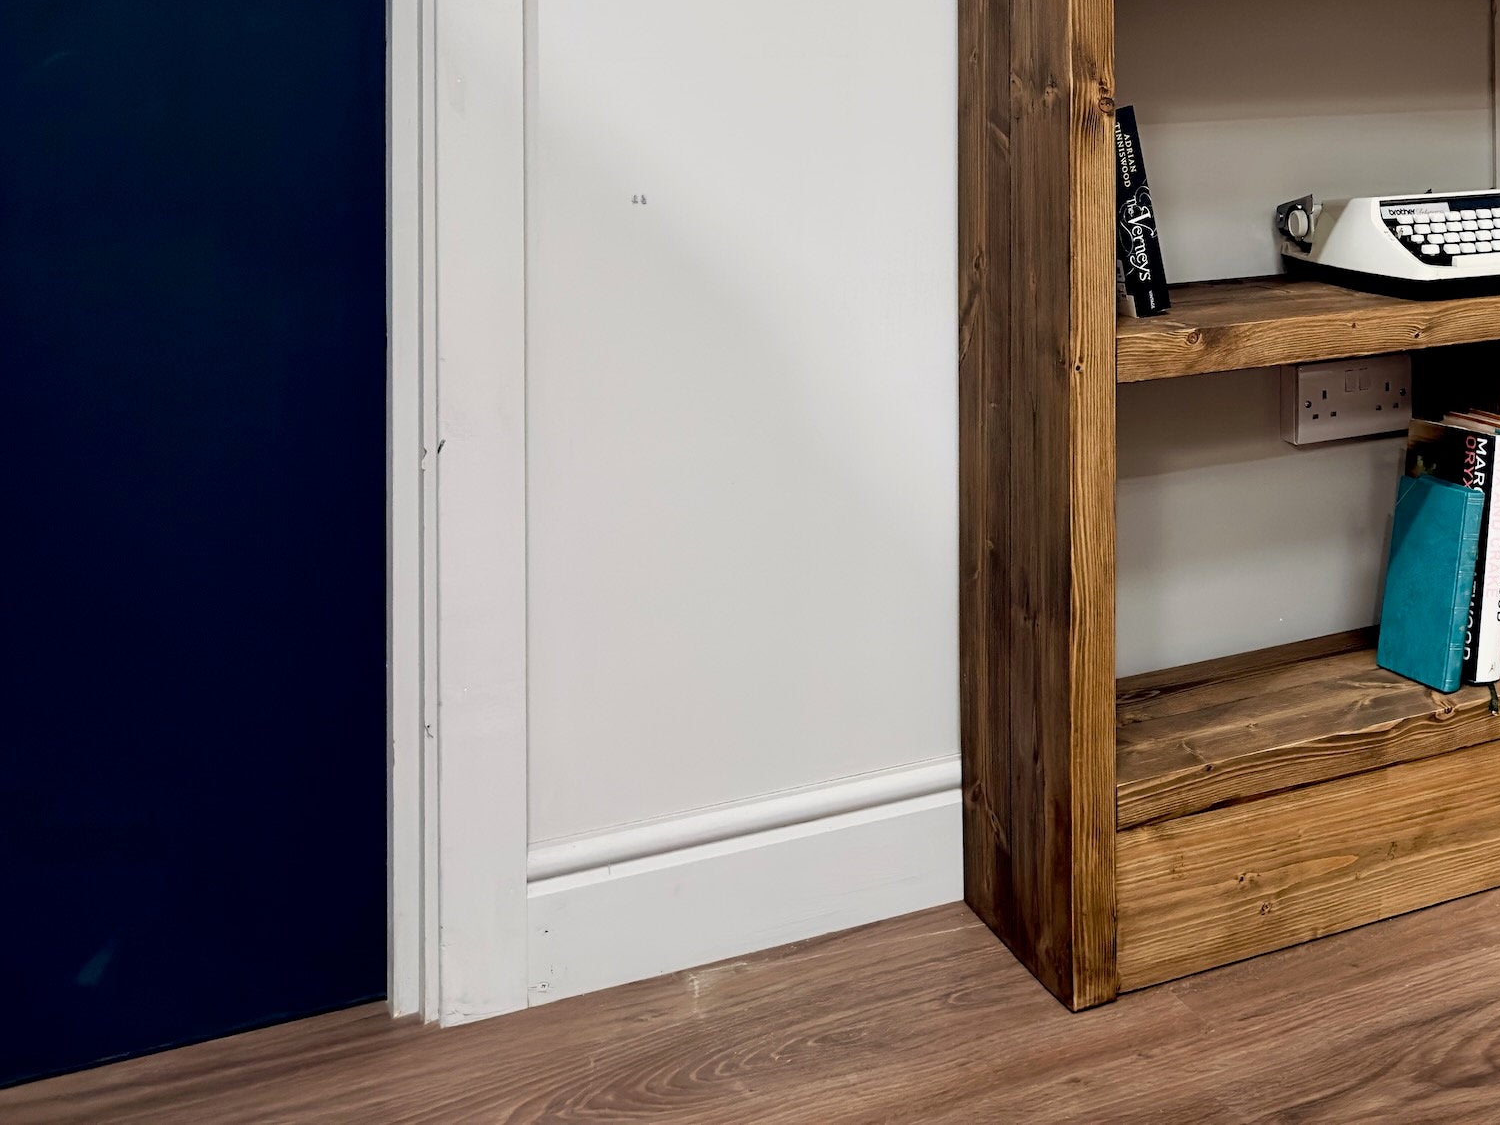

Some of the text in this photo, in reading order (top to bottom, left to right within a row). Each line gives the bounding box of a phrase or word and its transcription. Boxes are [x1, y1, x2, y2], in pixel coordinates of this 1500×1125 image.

[1115, 122, 1131, 188] TINNISWOOD
[1123, 133, 1137, 173] ADRIAN
[1388, 208, 1416, 216] brother
[1127, 206, 1155, 282] Verneys
[1462, 435, 1477, 488] ORYX
